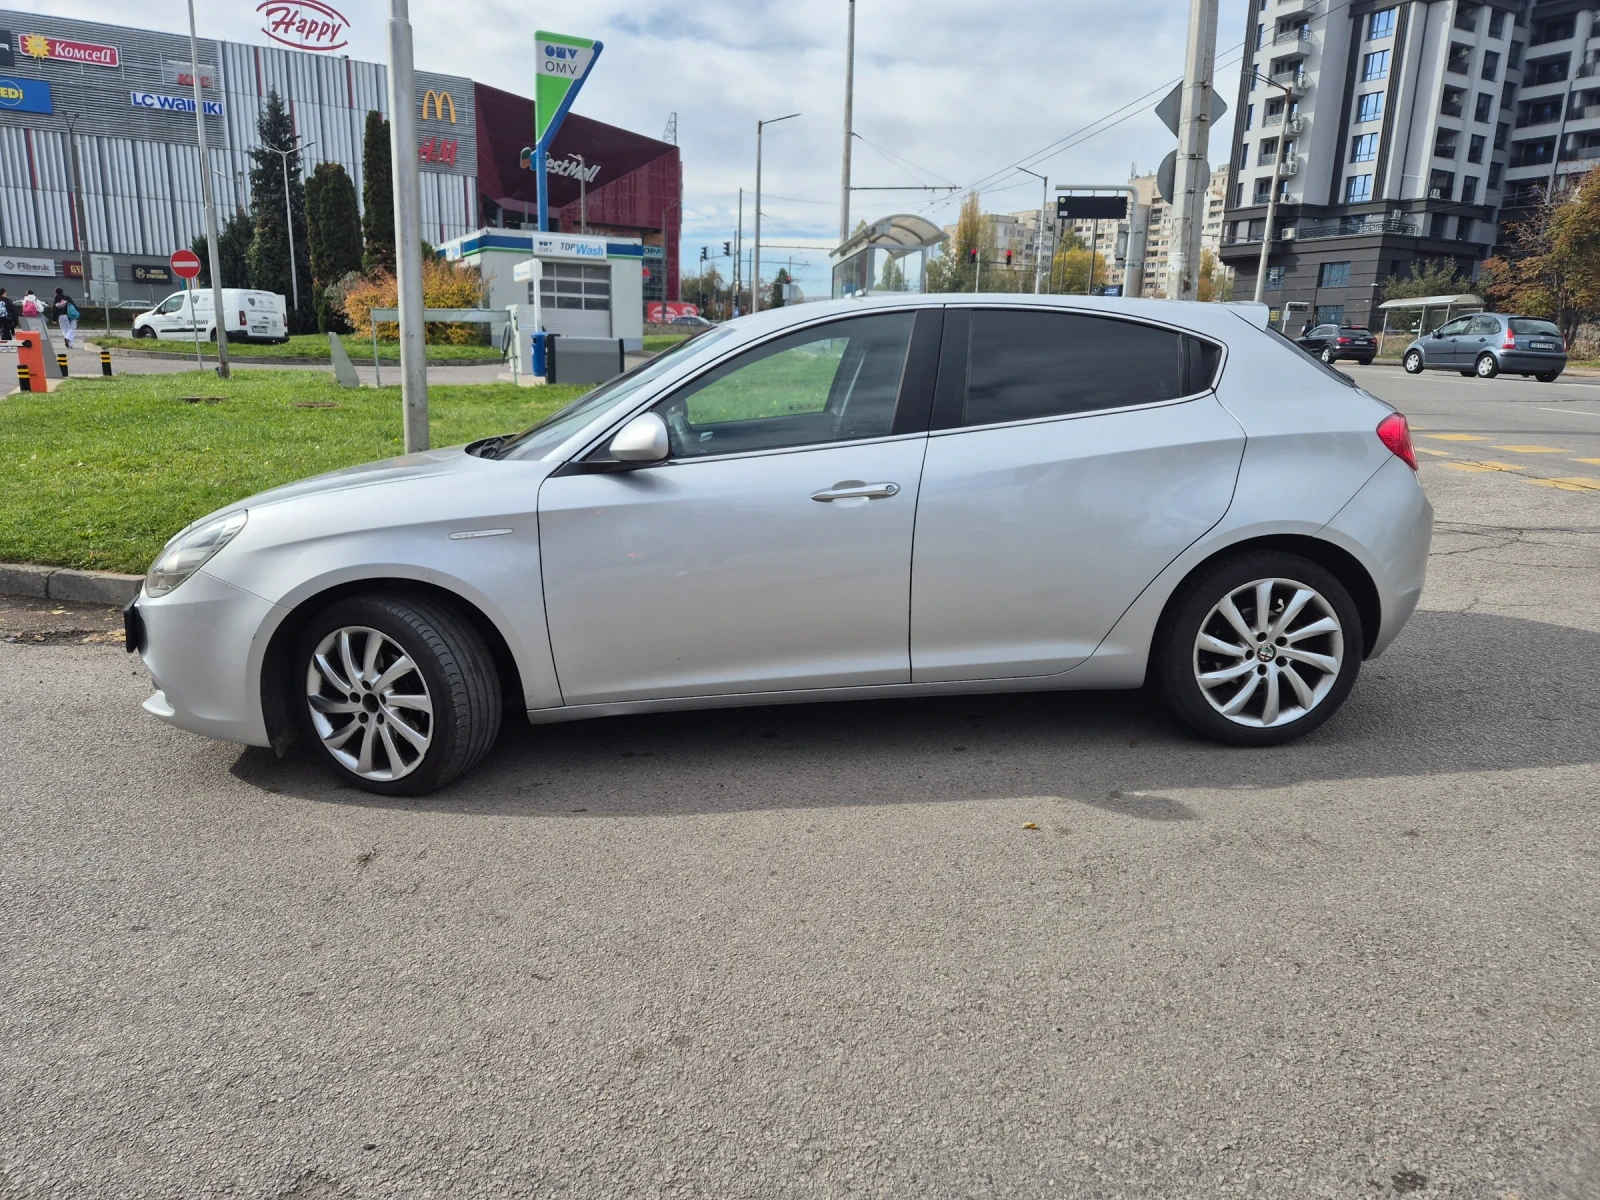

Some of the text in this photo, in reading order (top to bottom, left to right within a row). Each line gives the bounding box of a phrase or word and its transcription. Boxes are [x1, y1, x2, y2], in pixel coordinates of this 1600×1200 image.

[266, 6, 342, 42] Happy
[545, 60, 578, 75] OMV
[132, 92, 154, 107] LC
[561, 242, 604, 257] TOP Wash
